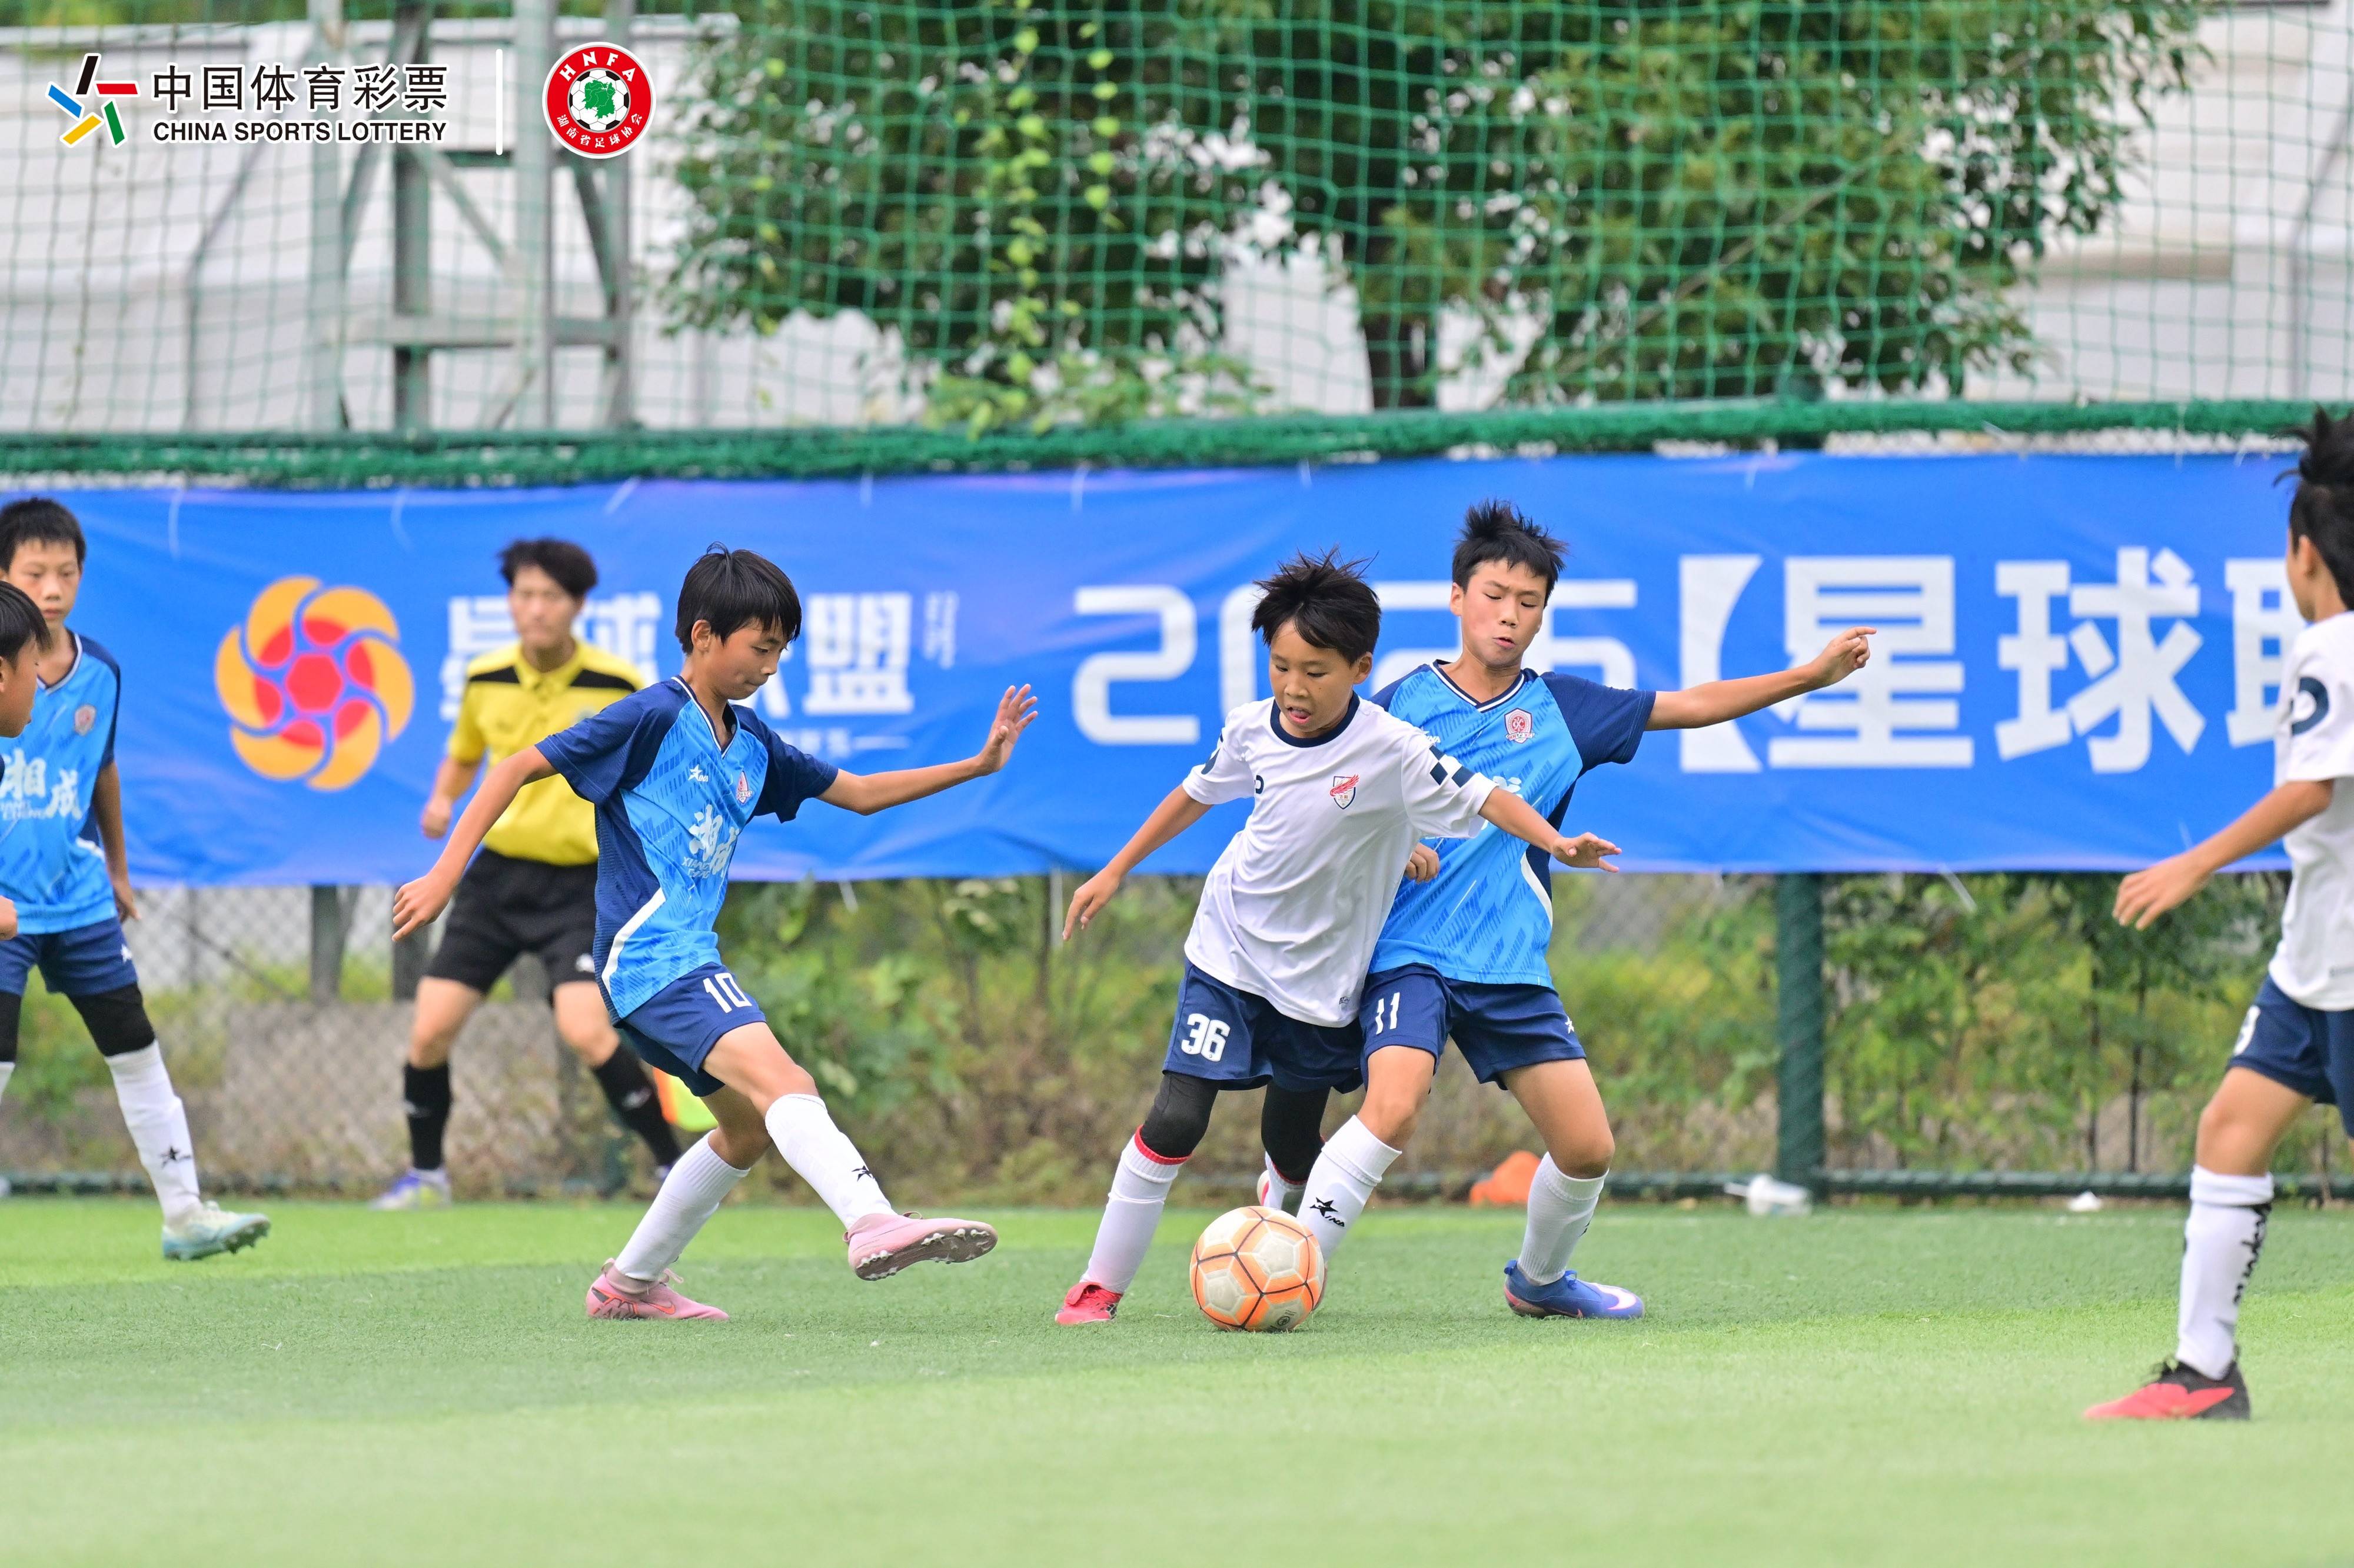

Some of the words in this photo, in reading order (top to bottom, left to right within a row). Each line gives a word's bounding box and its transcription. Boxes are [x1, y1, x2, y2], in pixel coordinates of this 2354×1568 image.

[703, 972, 753, 1014] 10
[1375, 991, 1400, 1035] 11
[1181, 1013, 1231, 1062] 36
